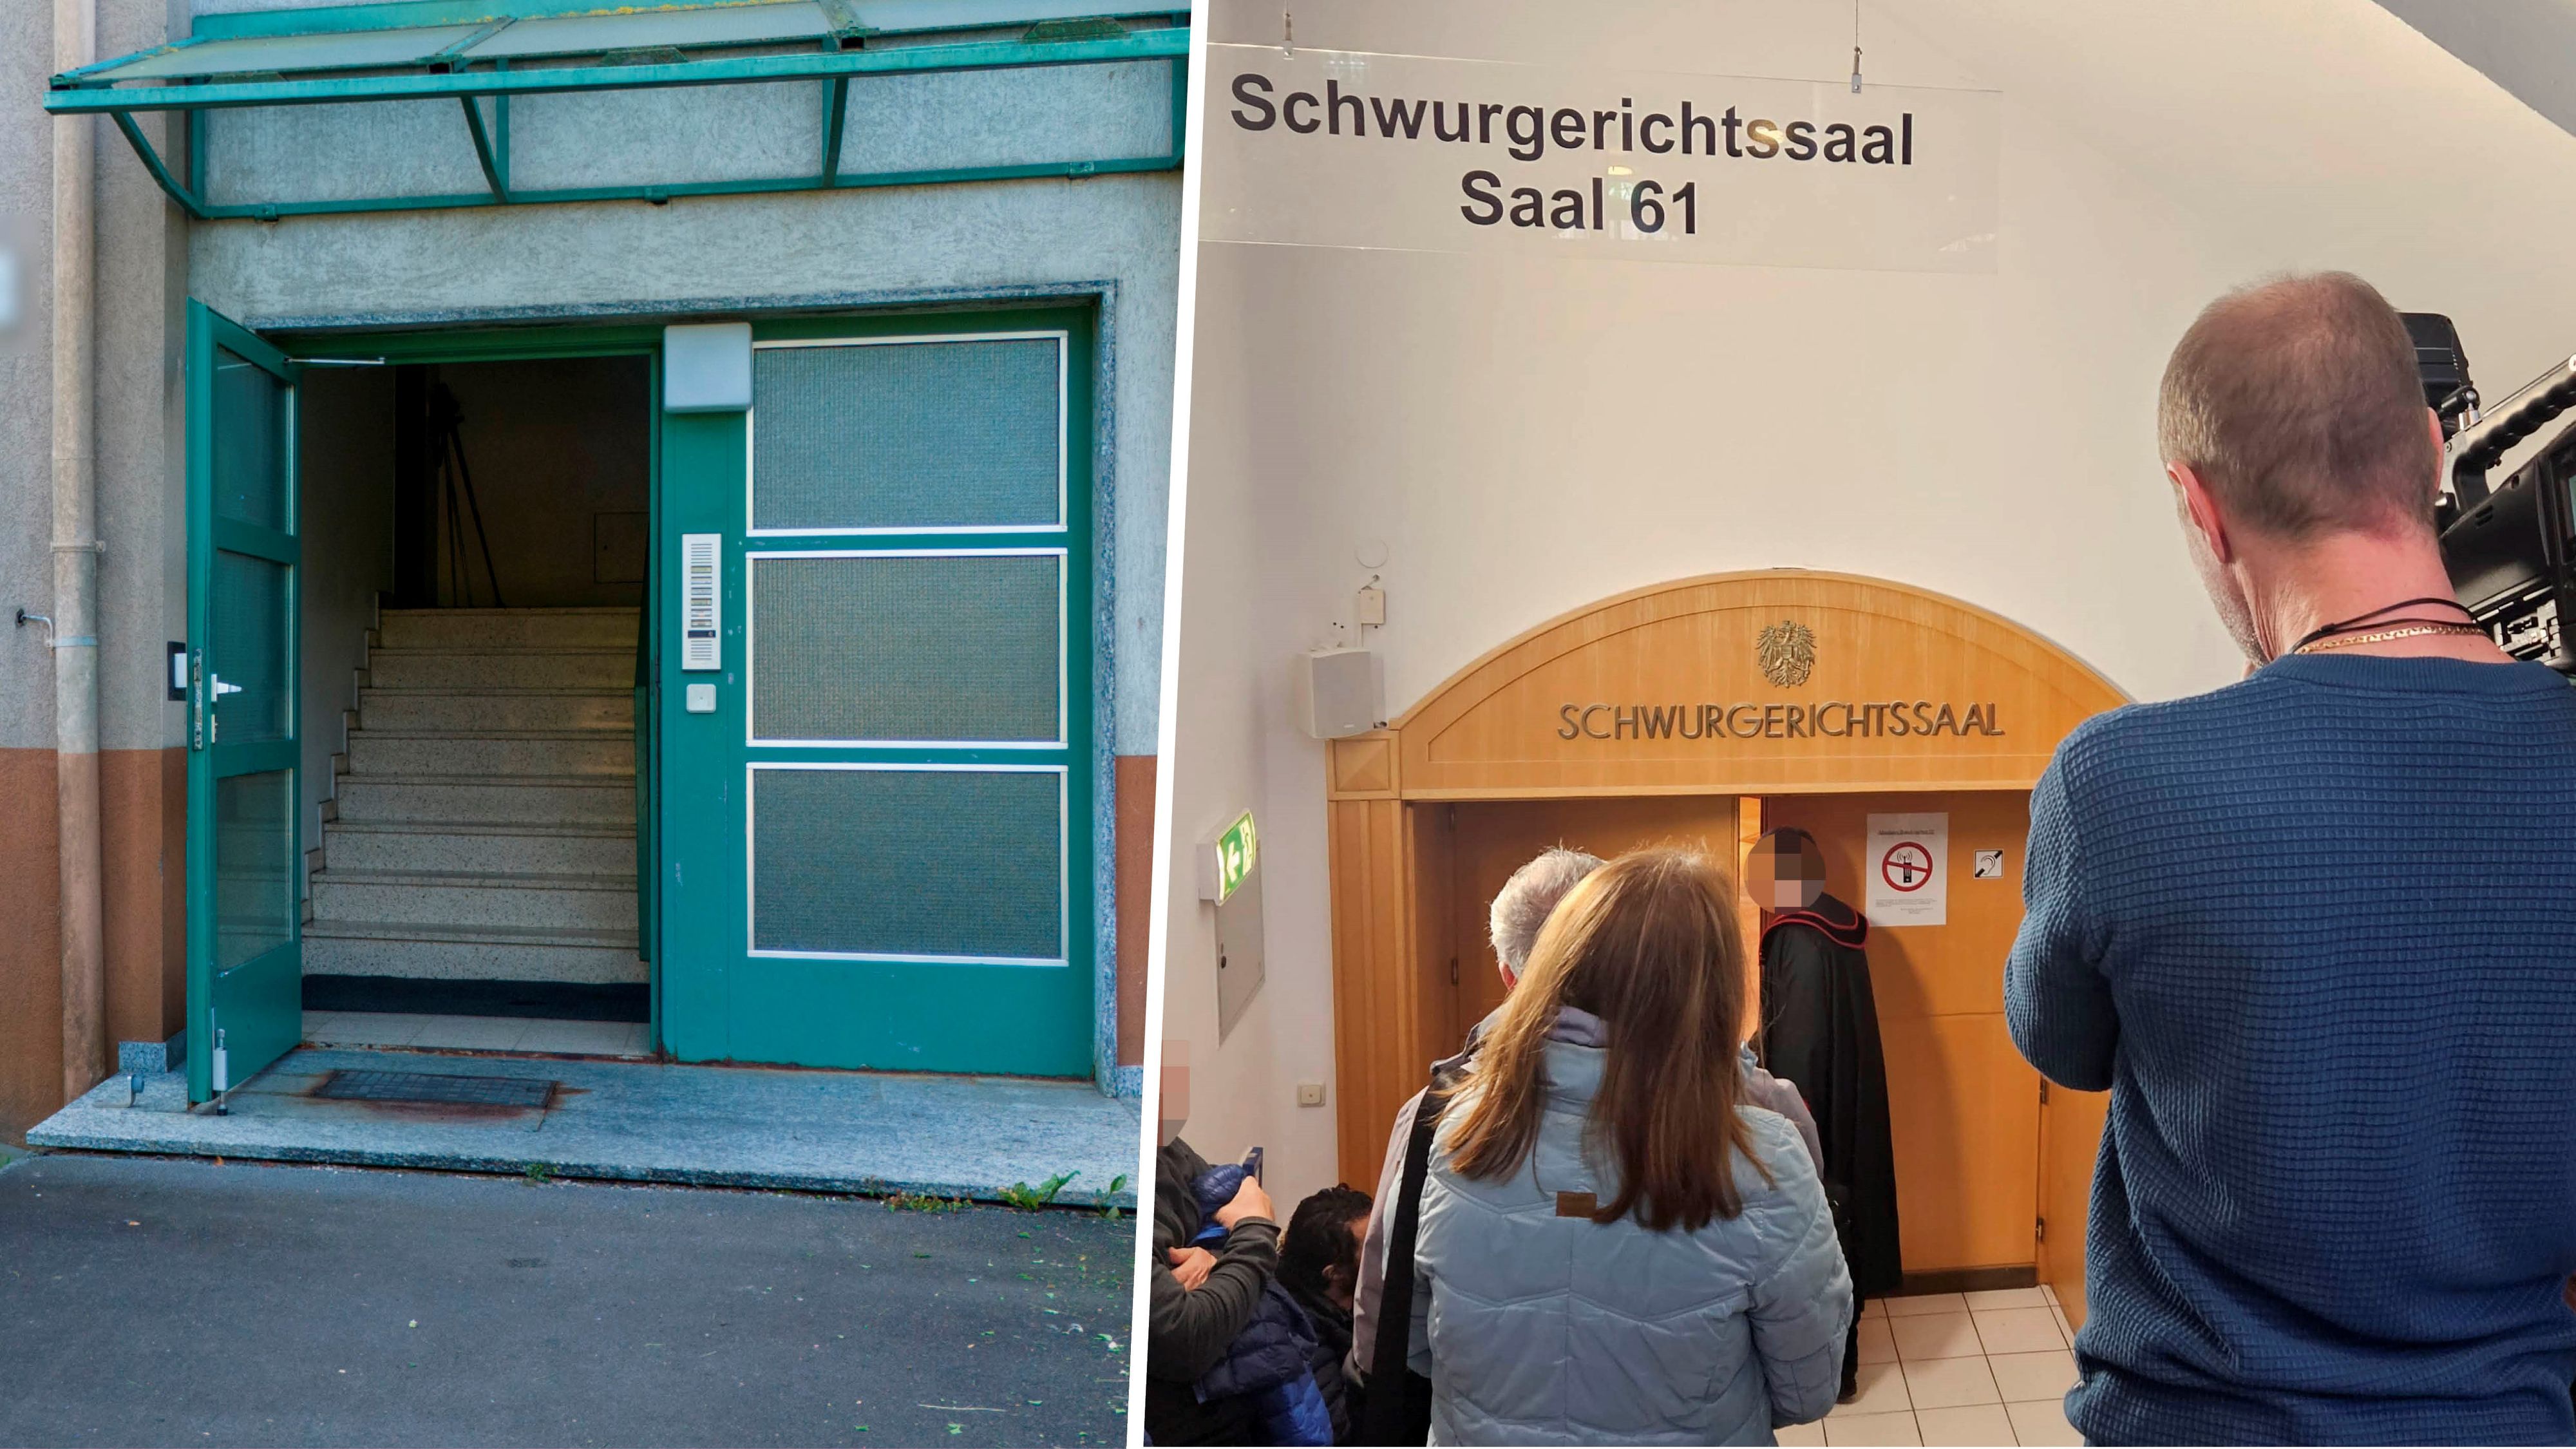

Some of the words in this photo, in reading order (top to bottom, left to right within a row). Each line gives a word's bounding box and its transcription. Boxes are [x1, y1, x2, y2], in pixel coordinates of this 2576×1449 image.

[1231, 73, 1912, 165] Schwurgerichtssaal
[1461, 170, 1603, 230] Saal
[1631, 180, 1696, 234] 61
[1557, 700, 2005, 740] SCHWURGERICHTSSAAL
